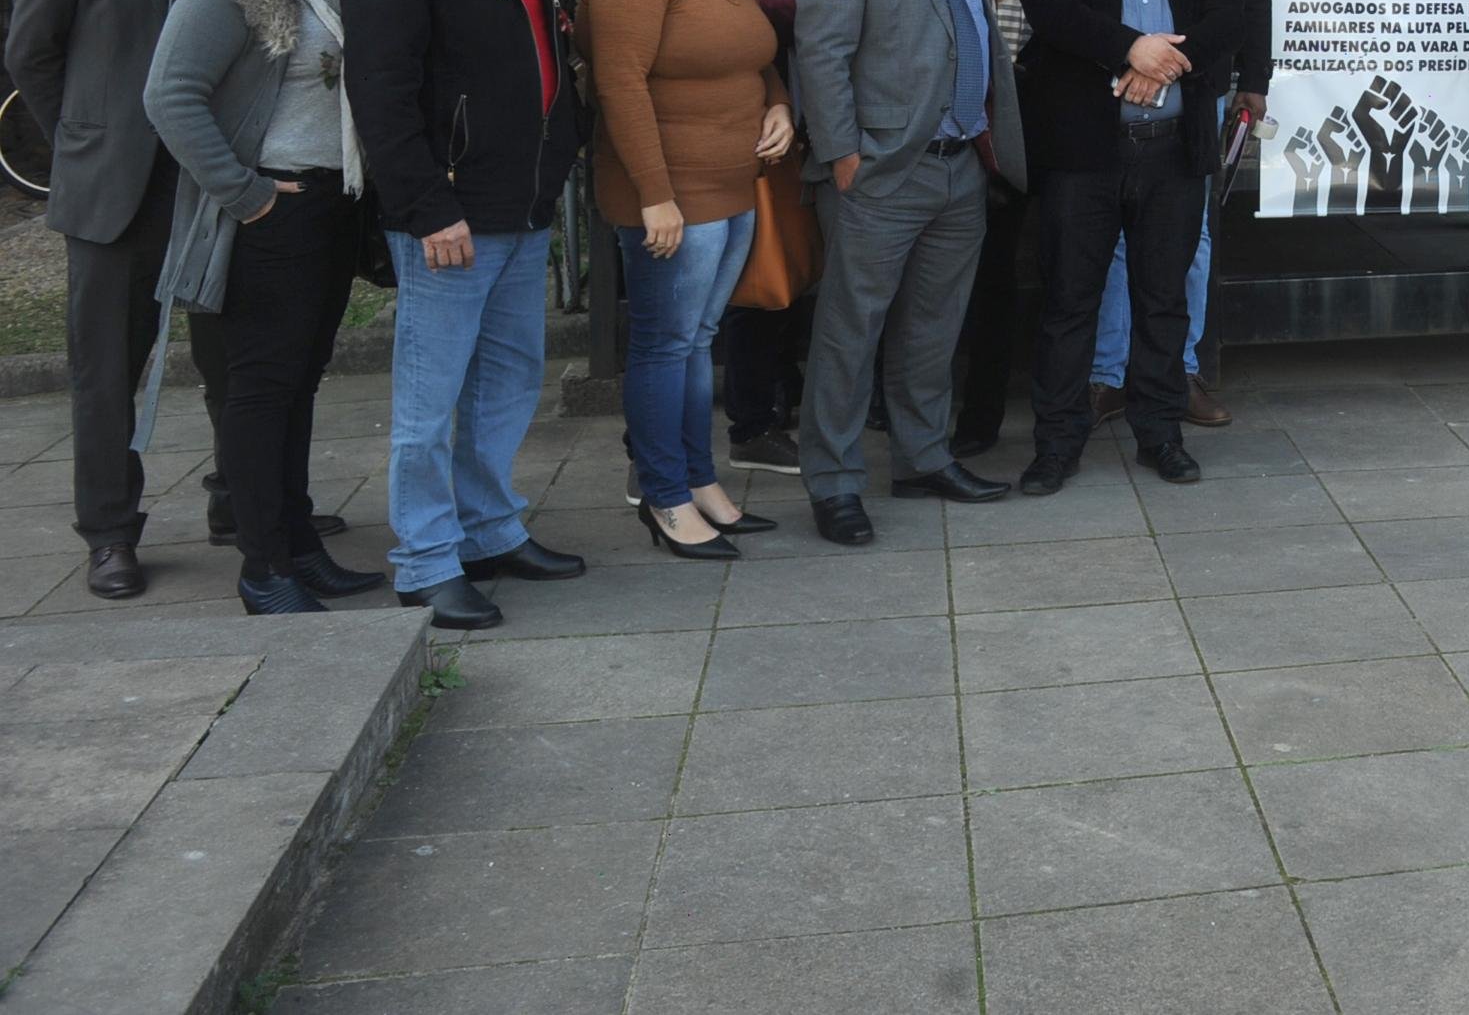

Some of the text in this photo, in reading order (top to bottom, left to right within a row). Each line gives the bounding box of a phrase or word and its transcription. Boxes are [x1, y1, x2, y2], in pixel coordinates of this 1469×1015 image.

[1287, 1, 1387, 15] ADVOGADOS
[1391, 2, 1411, 15] DE
[1415, 2, 1465, 15] DEFESA
[1285, 20, 1376, 34] FAMILIARES
[1380, 21, 1403, 34] NA
[1407, 21, 1443, 34] LUTA
[1282, 37, 1391, 56] MANUTENÇÃO
[1396, 40, 1417, 53] DA
[1420, 40, 1459, 53] VARA
[1383, 59, 1414, 72] DOS
